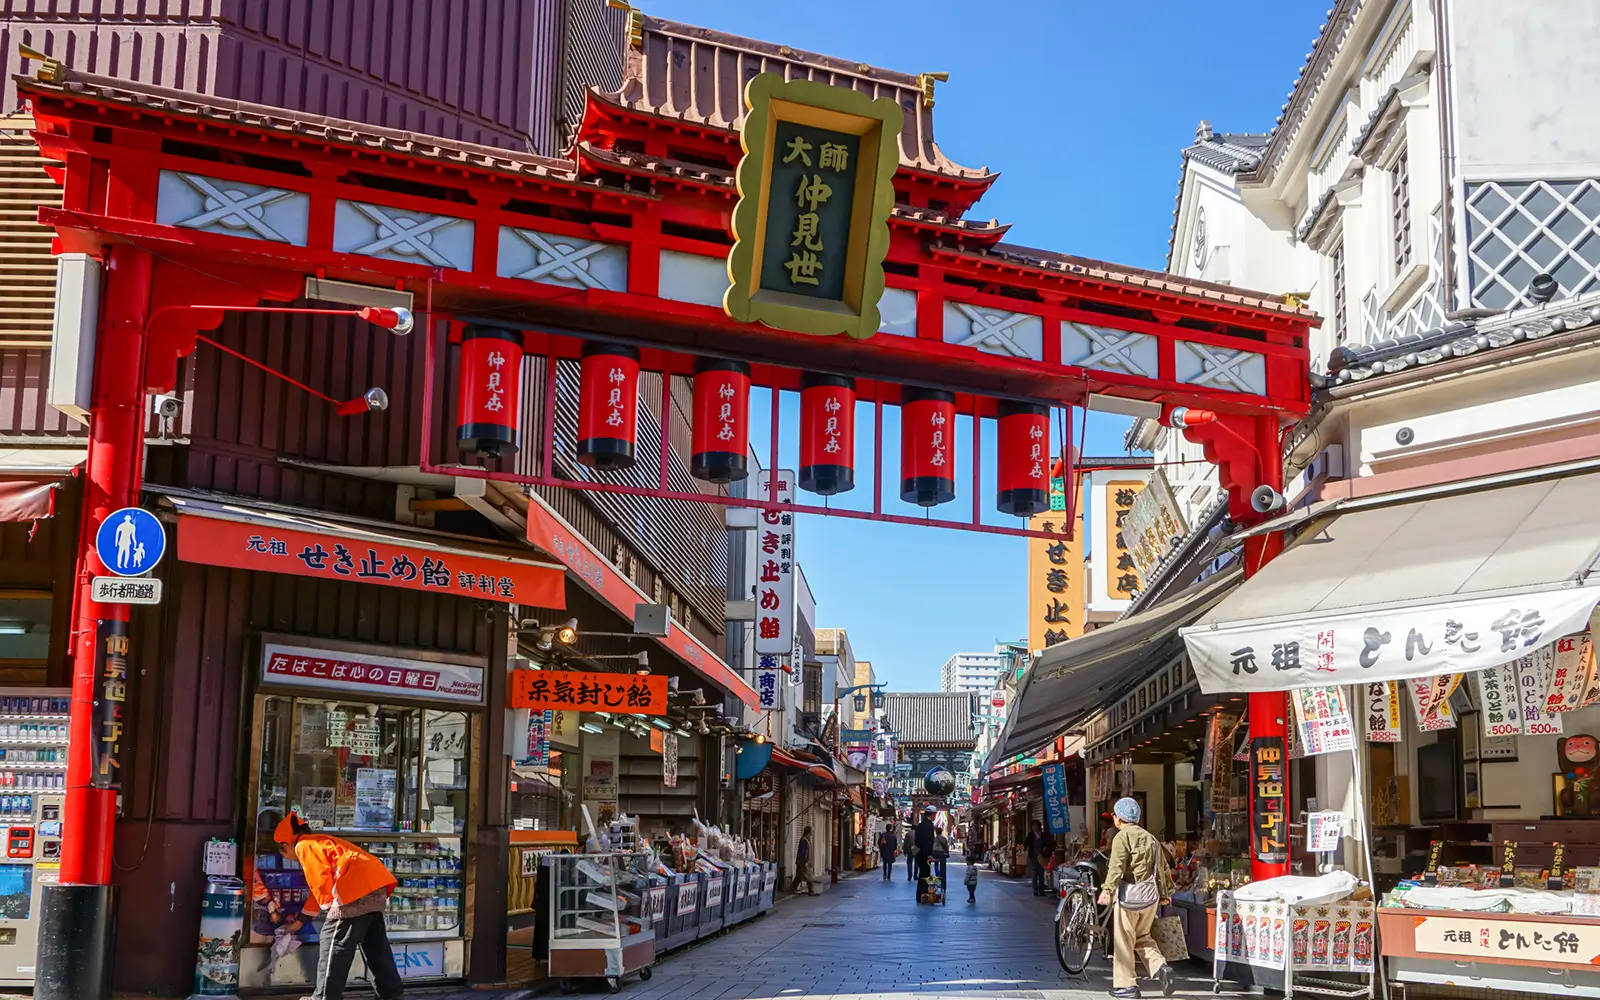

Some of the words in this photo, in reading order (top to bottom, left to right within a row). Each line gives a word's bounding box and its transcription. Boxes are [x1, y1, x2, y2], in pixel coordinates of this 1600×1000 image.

[783, 136, 849, 173] 大師
[783, 174, 833, 286] 仲見世
[484, 351, 506, 412] 仲見世
[606, 367, 626, 427] 仲見世
[716, 382, 737, 441] 仲見世
[824, 397, 841, 454] 仲見世
[930, 411, 946, 467] 仲見世
[1028, 425, 1044, 479] 仲見世
[246, 535, 288, 556] 元祖
[297, 543, 451, 588] せき止め飴
[458, 571, 515, 598] 評判堂
[759, 508, 781, 639] せき止め飴
[781, 533, 792, 574] 評判堂
[99, 582, 154, 599] 歩行者用道路
[1044, 540, 1071, 648] せき止飴
[271, 656, 436, 689] たばこは心の日曜日
[1230, 641, 1301, 675] 元祖
[1316, 629, 1336, 673] 開運
[528, 679, 652, 708] 呆気封じ飴
[1315, 690, 1329, 718] 千歳飴
[1520, 653, 1540, 721] 声のど飴
[1491, 724, 1519, 735] 500円
[1530, 723, 1558, 734] 500円
[1443, 930, 1472, 943] 元祖
[1480, 928, 1490, 948] 開運
